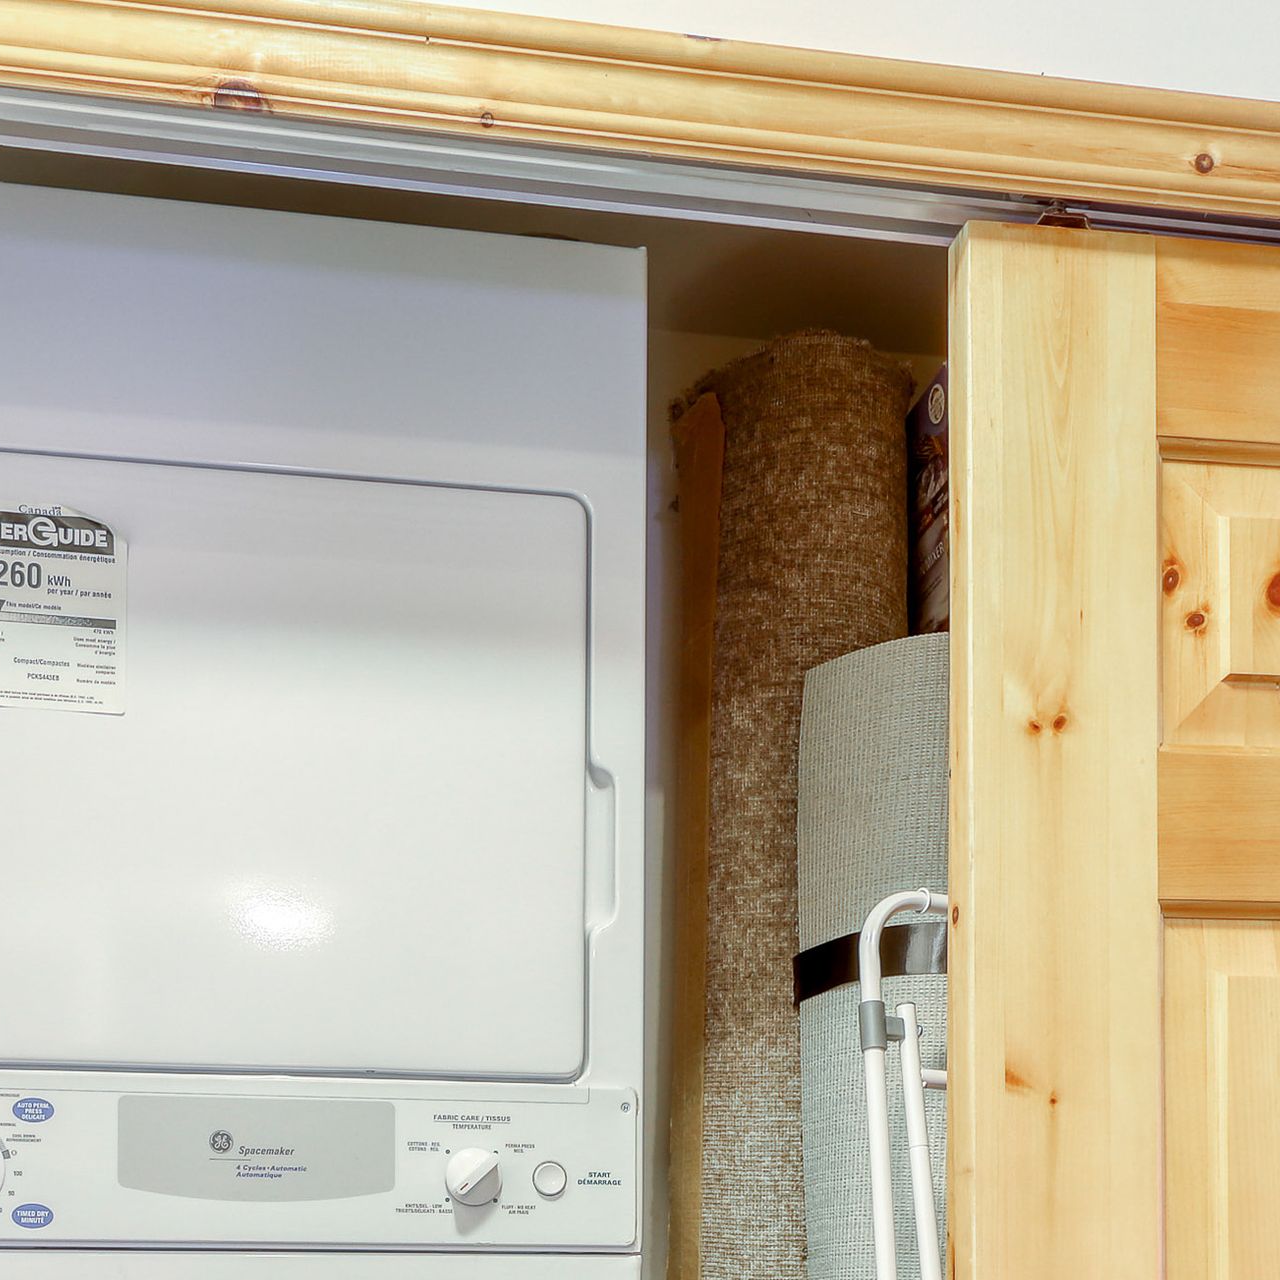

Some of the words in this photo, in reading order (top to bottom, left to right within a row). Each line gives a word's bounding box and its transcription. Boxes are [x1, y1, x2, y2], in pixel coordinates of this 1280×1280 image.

[19, 504, 62, 516] Canada
[32, 550, 77, 560] Consommation
[47, 574, 71, 587] kWh
[238, 1145, 295, 1157] Spacemaker
[243, 1164, 266, 1172] Cycles
[577, 1177, 622, 1186] DÉMARRAGE
